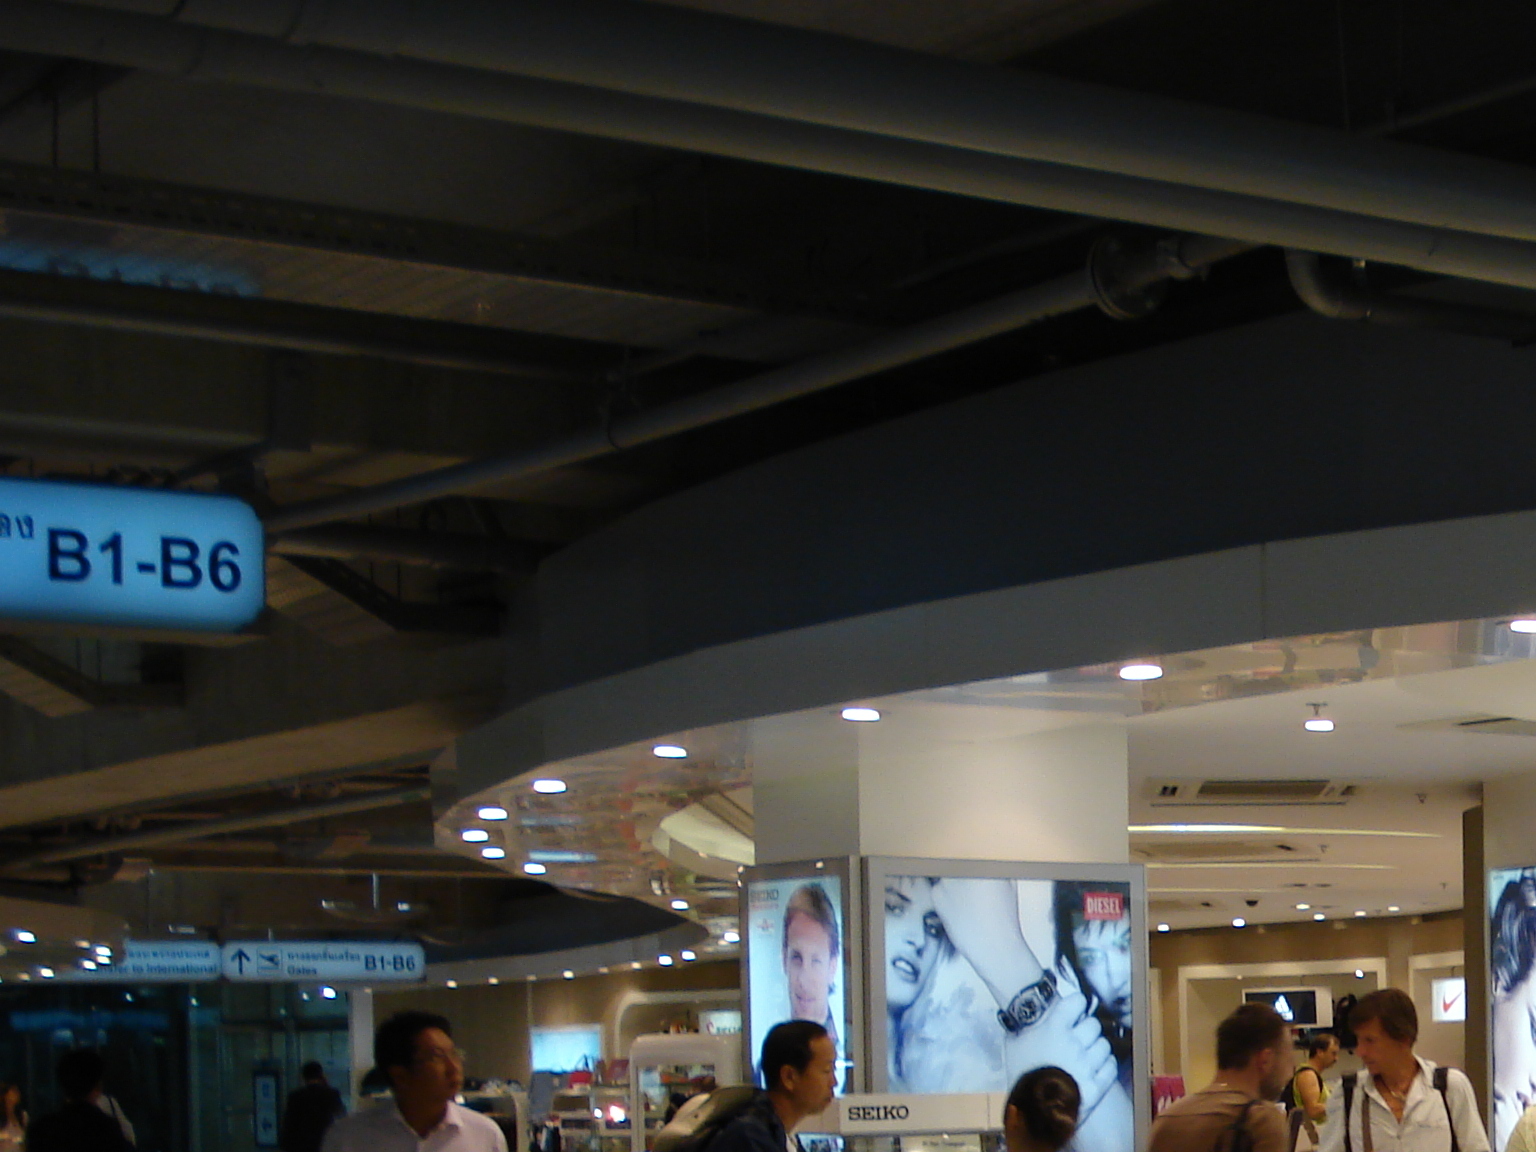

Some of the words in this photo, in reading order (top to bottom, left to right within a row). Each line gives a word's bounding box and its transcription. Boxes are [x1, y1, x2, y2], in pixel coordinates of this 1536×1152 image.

[47, 527, 241, 592] B1-B6
[1087, 897, 1120, 914] DIESEL
[364, 954, 416, 972] B1-B6
[848, 1105, 909, 1120] SEIKO
